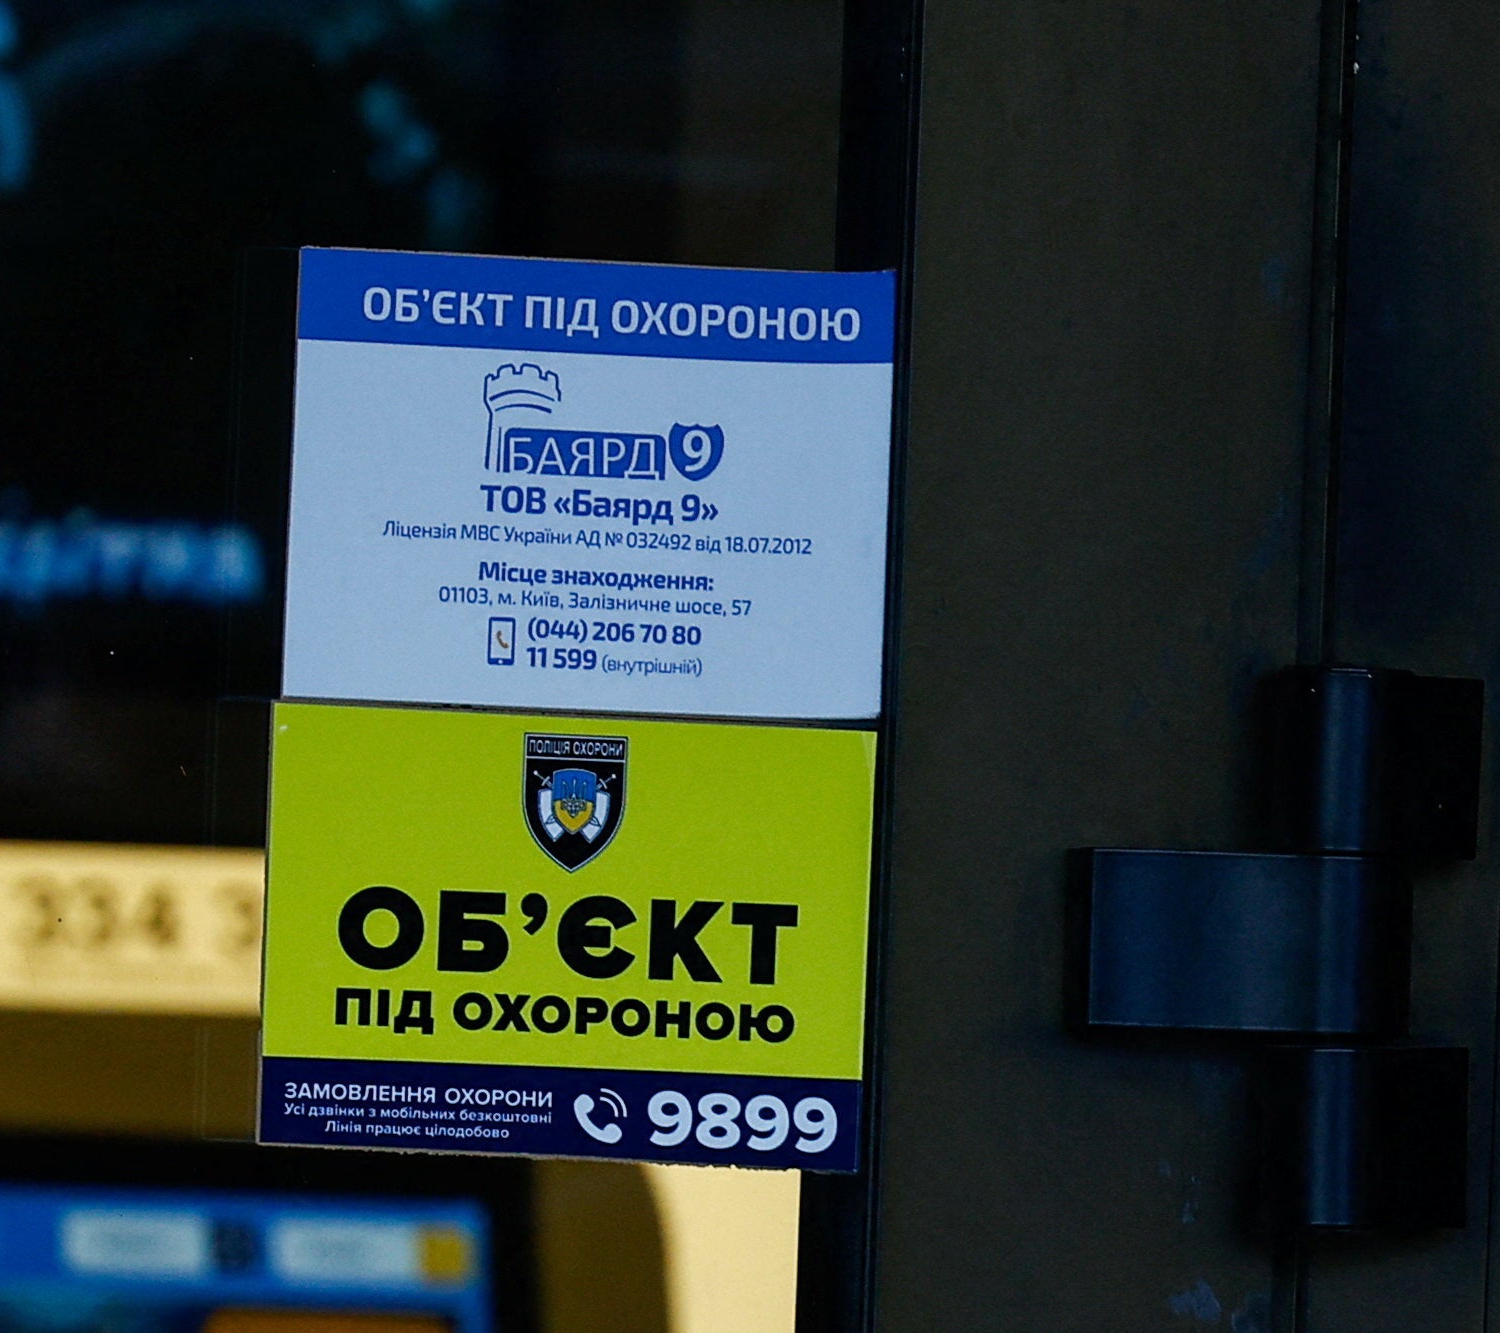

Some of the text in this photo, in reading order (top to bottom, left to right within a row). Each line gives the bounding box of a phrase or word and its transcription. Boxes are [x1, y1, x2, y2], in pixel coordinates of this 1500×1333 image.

[363, 286, 861, 342] ОБ’ЄКТ ПІД ОХОРОНОЮ
[509, 430, 712, 480] БАЯРД 9
[480, 484, 719, 525] ТОВ «Баярд 9»
[383, 520, 812, 555] Ліцензія МВС України АД № 032492 від 18.07.2012
[478, 561, 715, 592] Місце знаходження:
[438, 586, 752, 617] 01103, м. Київ, Залізничне шосе, 57
[527, 617, 702, 646] (044) 206 70 80
[526, 647, 704, 677] 11 599 (внутрішній)
[338, 886, 799, 985] ОБ’ЄКТ
[334, 987, 796, 1043] ПІД ОХОРОНОЮ
[284, 1082, 553, 1108] ЗАМОВЛЕННЯ ОХОРОНИ
[284, 1102, 305, 1116] Усі
[308, 1105, 364, 1118] дзвінки
[380, 1107, 456, 1121] мобільних
[459, 1110, 552, 1124] безкоштовні
[648, 1090, 838, 1154] 9899
[324, 1120, 510, 1140] Лінія працює цілодобово
